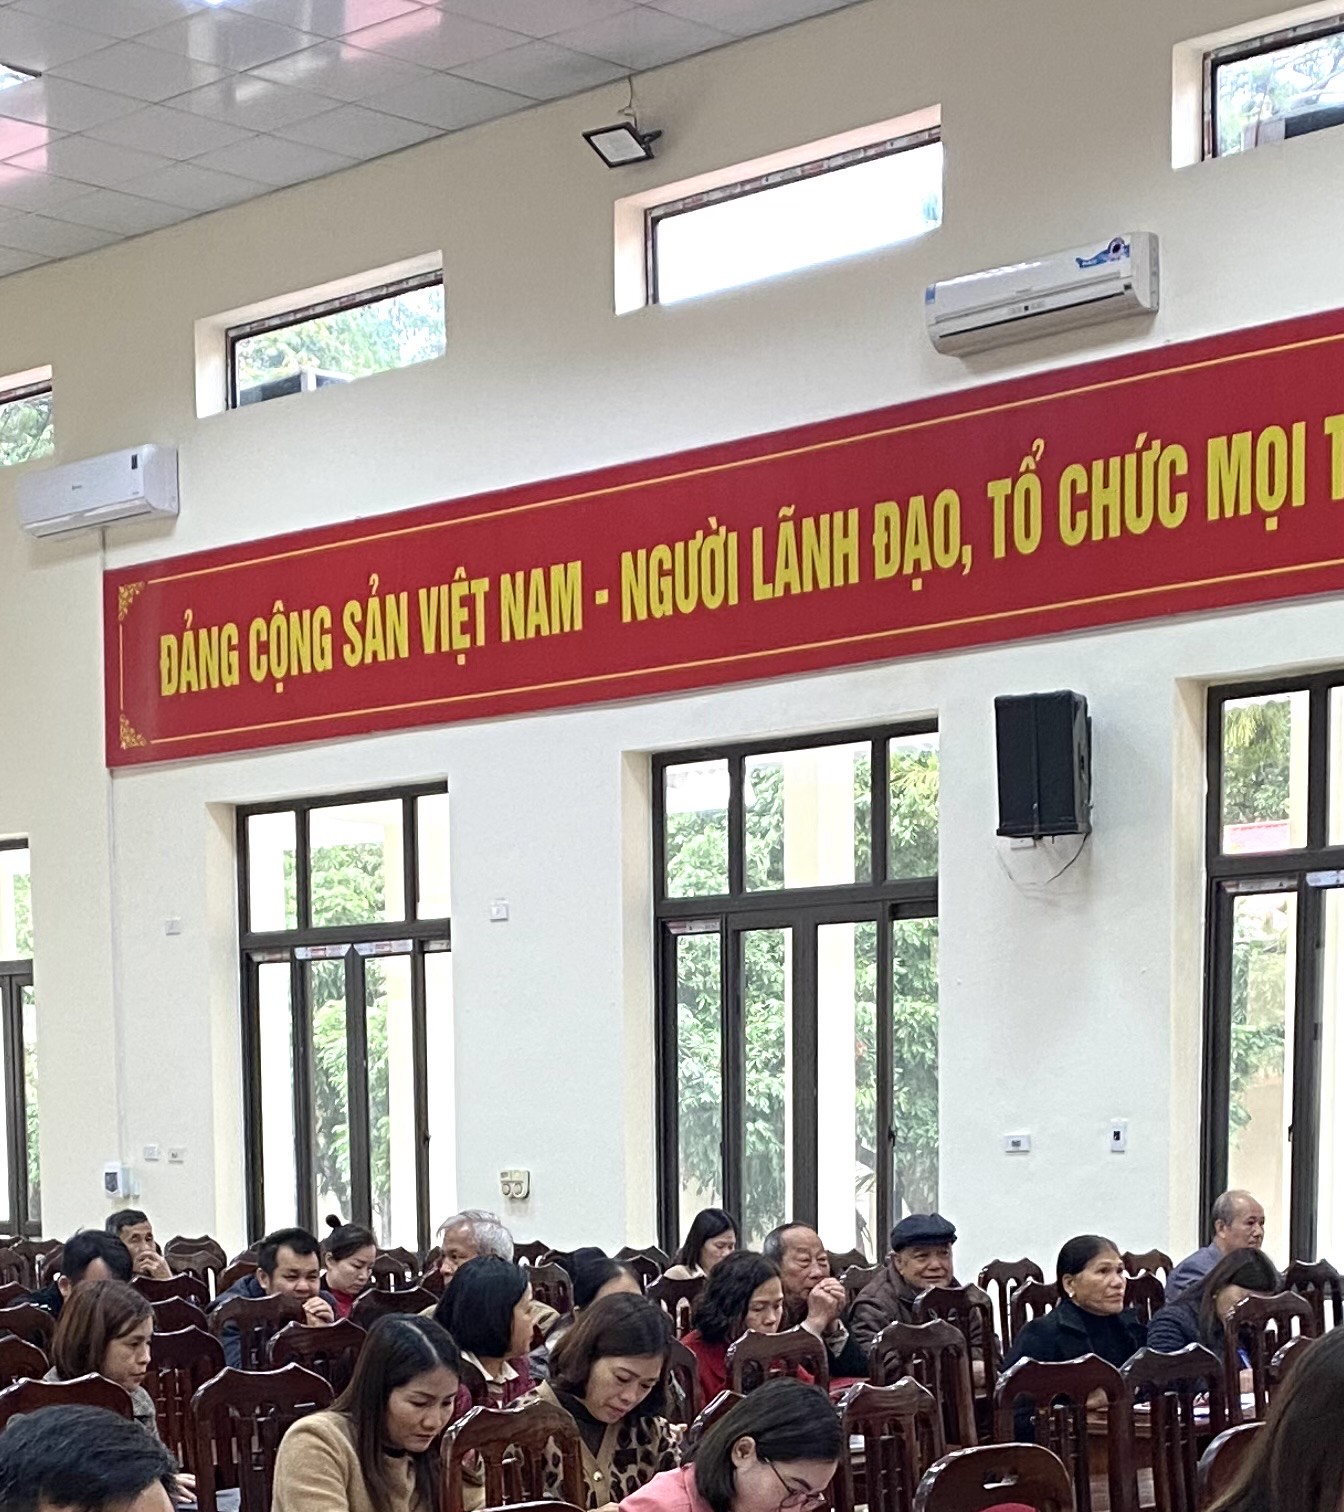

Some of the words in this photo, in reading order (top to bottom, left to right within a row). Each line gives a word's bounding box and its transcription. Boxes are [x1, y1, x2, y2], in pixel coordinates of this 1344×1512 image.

[159, 609, 240, 697] ĐẢNG
[249, 600, 333, 693] CỘNG
[342, 573, 409, 667] SẢN
[418, 566, 490, 665] VIỆT
[501, 562, 582, 640] NAM
[621, 516, 738, 621] NGƯỜI
[752, 502, 859, 600] LÃNH
[873, 490, 972, 592] ĐẠO,
[988, 438, 1044, 557] TỔ
[1058, 432, 1188, 547] CHỨC
[1206, 423, 1306, 531] MỌI
